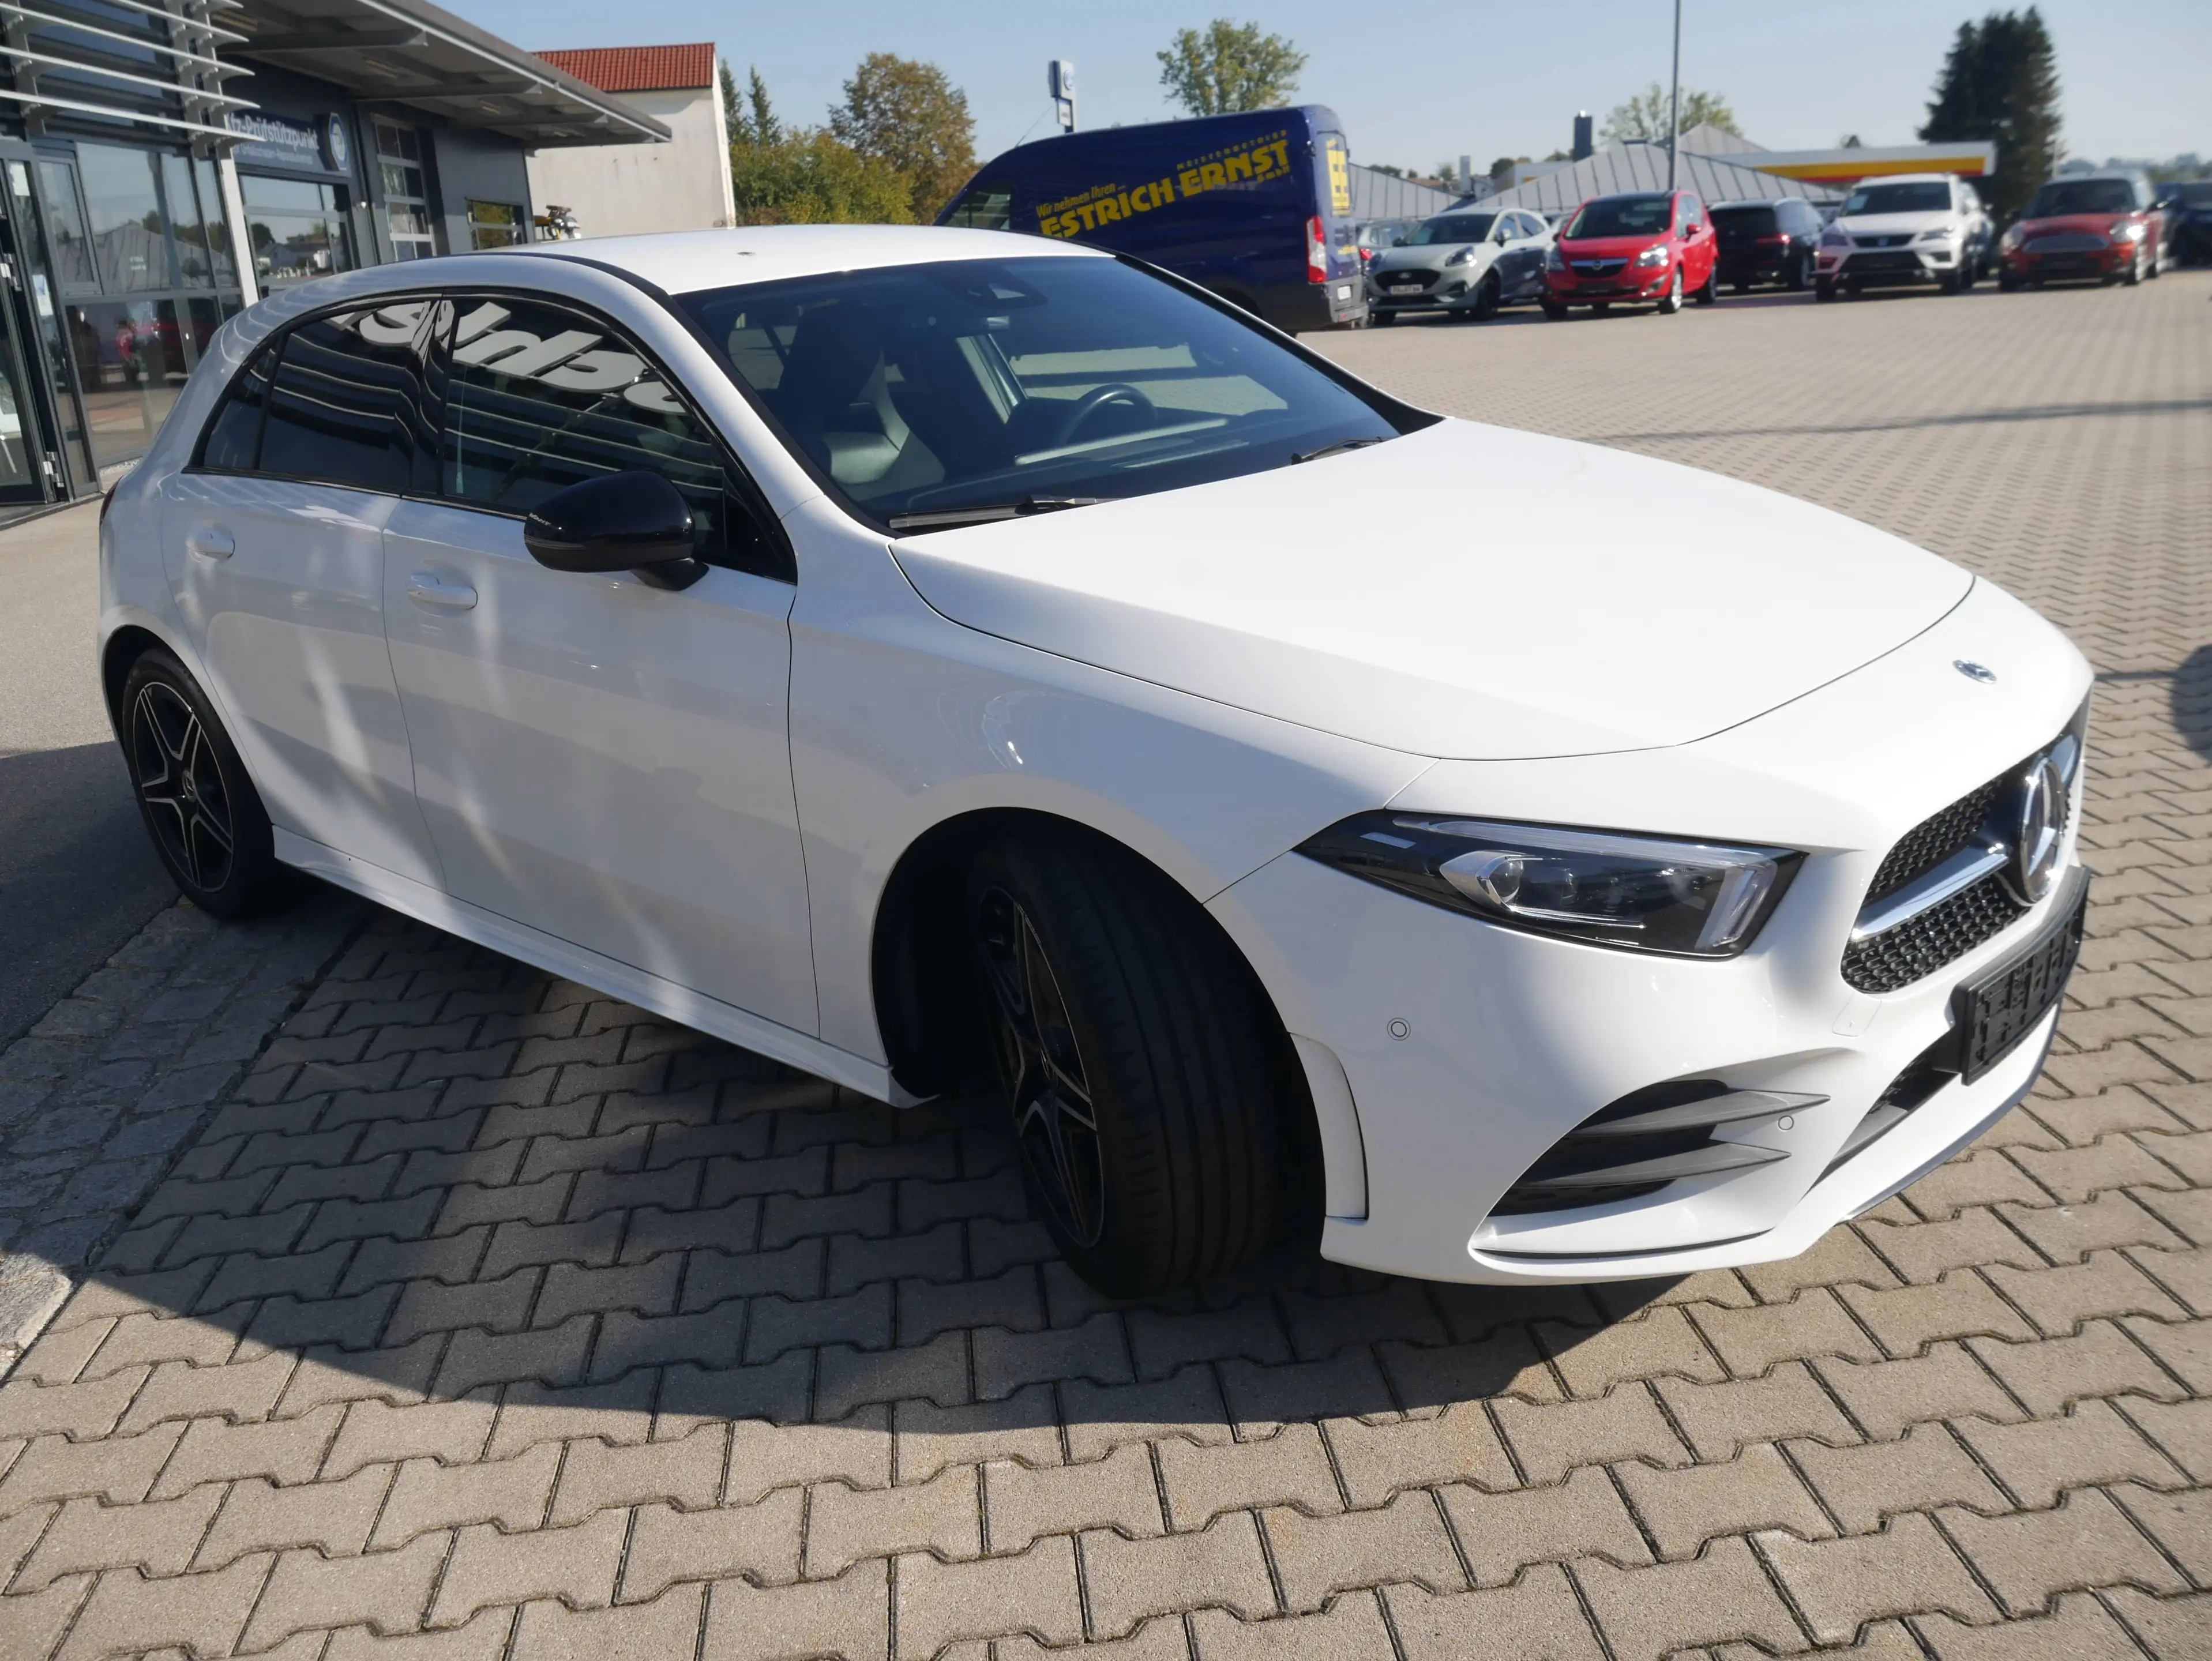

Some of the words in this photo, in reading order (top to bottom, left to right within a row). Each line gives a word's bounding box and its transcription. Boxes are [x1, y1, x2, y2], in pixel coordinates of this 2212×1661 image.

[1036, 202, 1052, 218] Wir
[1054, 192, 1090, 212] nehmen
[1091, 183, 1116, 199] Ihren
[1040, 177, 1176, 238] ESTRICH
[1179, 139, 1289, 198] ERNST
